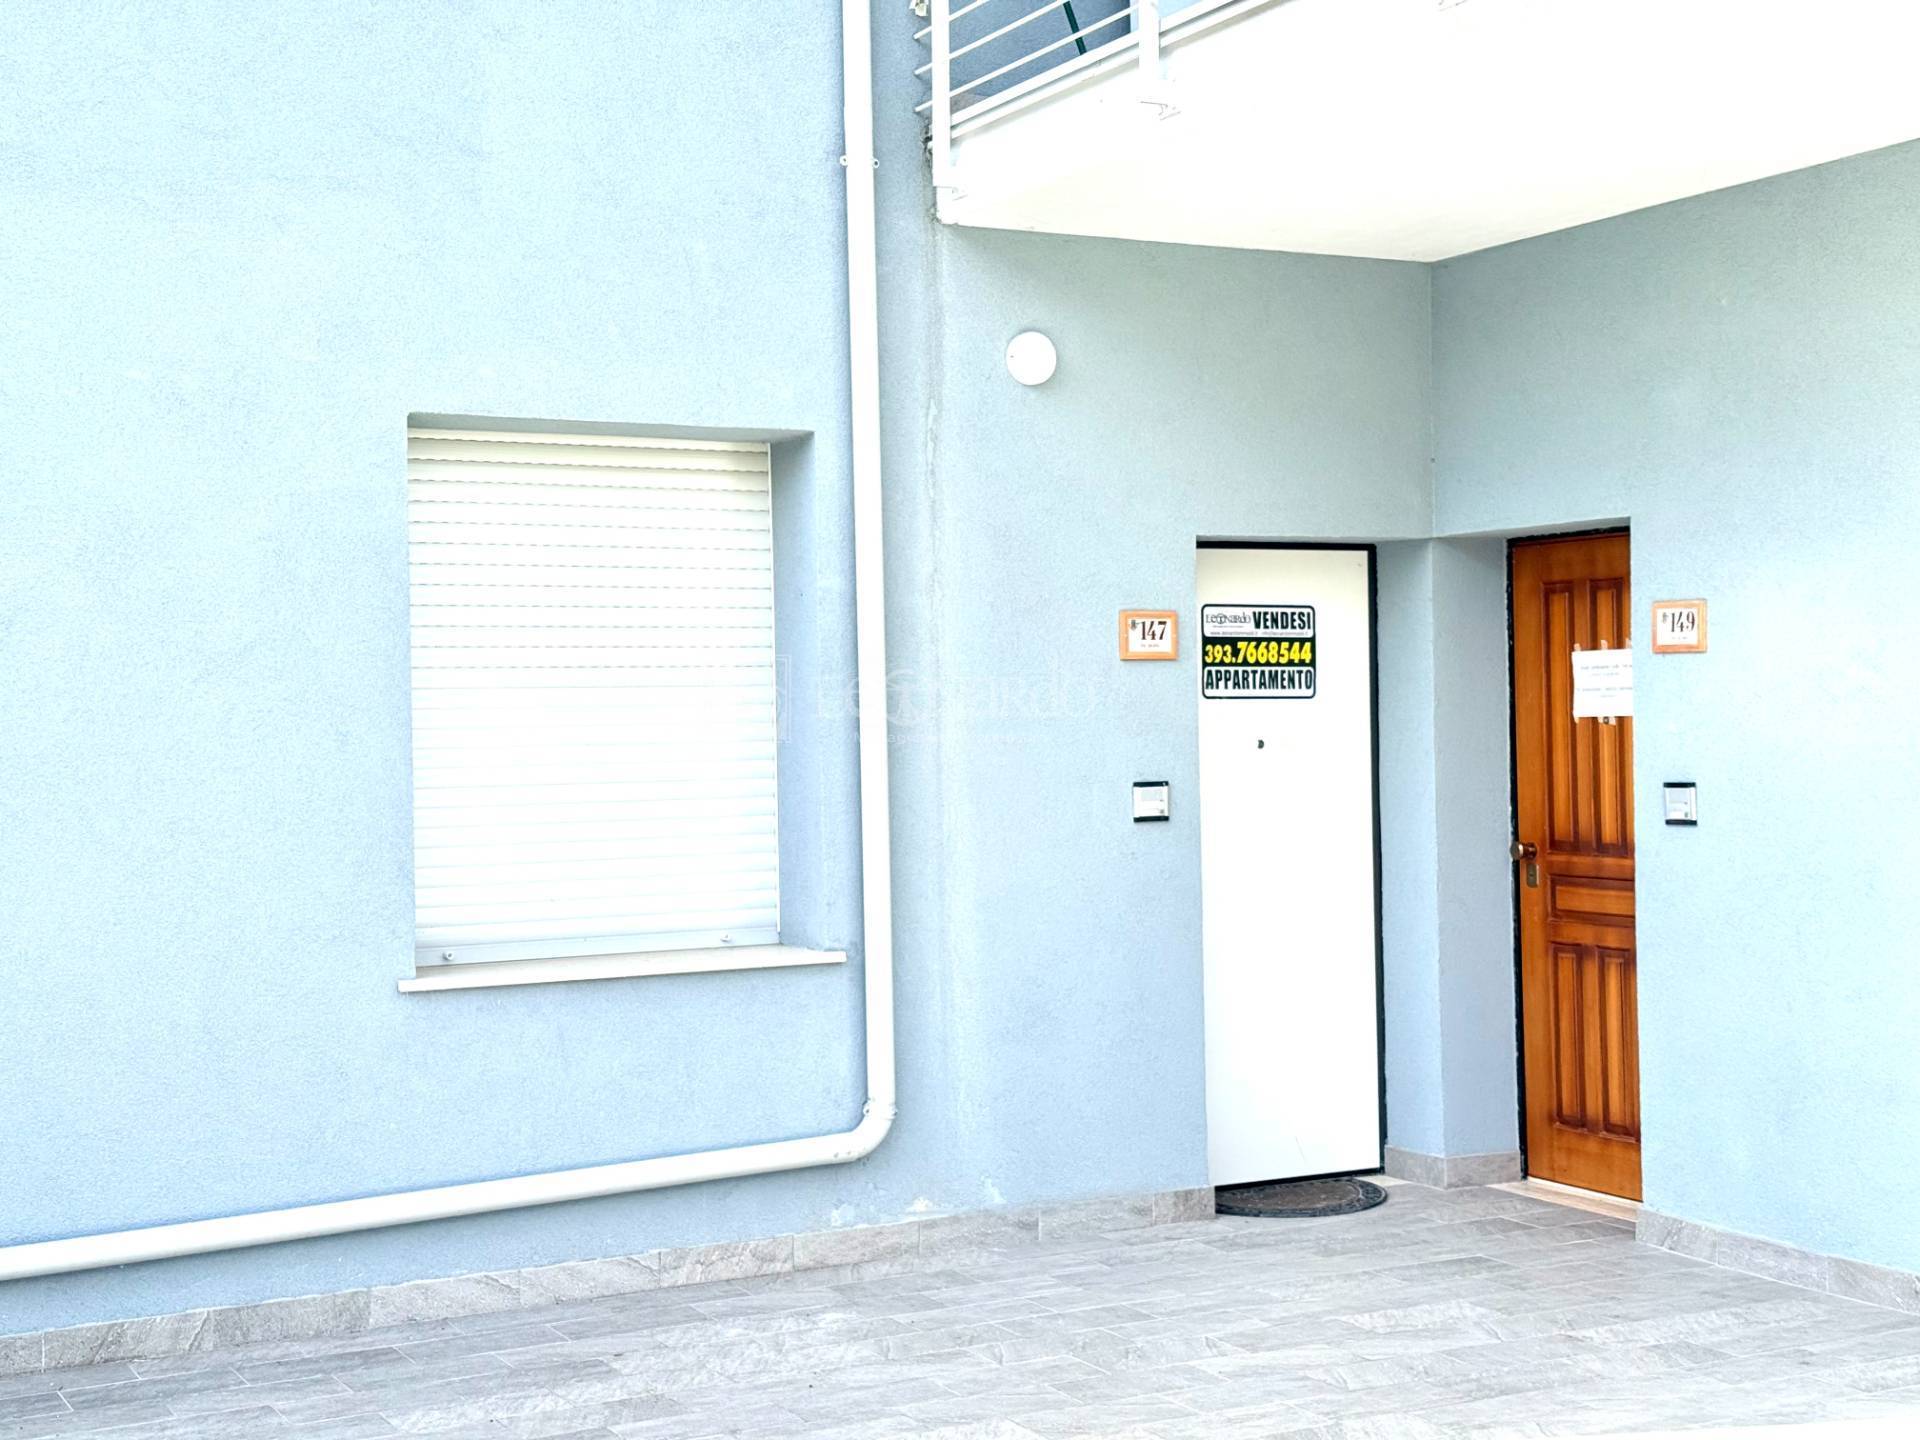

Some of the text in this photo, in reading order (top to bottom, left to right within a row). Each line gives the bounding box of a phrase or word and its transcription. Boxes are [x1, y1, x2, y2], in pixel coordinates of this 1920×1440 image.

[1140, 620, 1168, 641] 147
[1252, 611, 1311, 629] VENDESI
[1670, 611, 1695, 632] 149
[1205, 642, 1312, 663] 393.7668544
[1205, 669, 1312, 689] APPARTAMENTO
